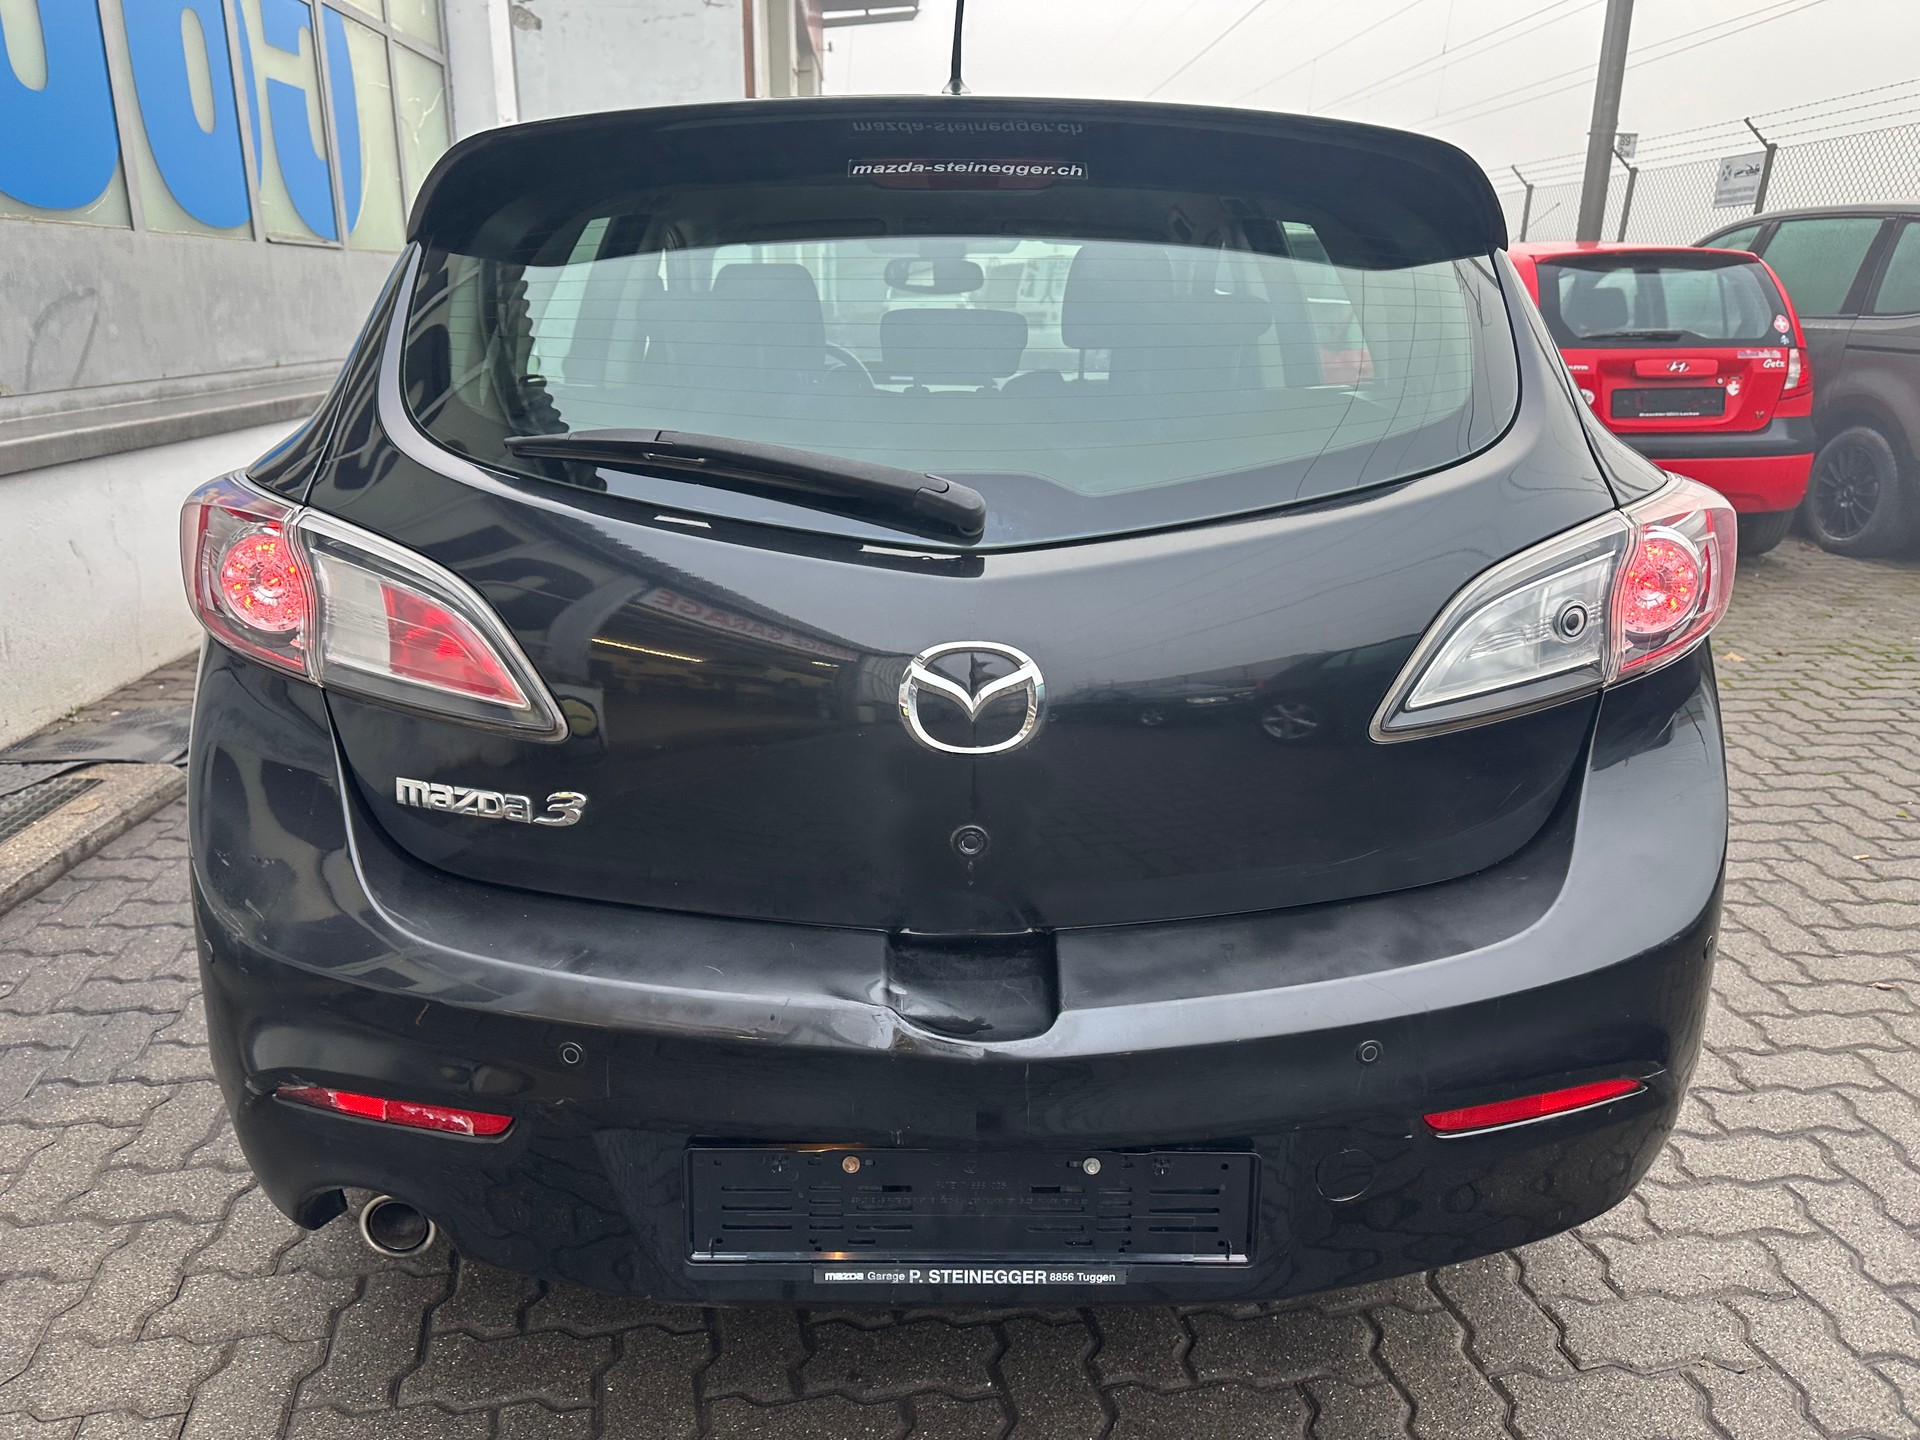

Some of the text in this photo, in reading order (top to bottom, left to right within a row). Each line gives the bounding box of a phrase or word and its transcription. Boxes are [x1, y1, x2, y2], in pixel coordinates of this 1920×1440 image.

[852, 161, 1083, 176] mazda-steinegger.ch
[1763, 359, 1785, 369] Getz
[533, 791, 587, 827] 3
[867, 1271, 905, 1283] Garage
[909, 1270, 924, 1283] P.
[928, 1269, 1047, 1284] STEINEGGER
[1050, 1273, 1074, 1282] 8856
[1077, 1272, 1116, 1283] Tuggen
